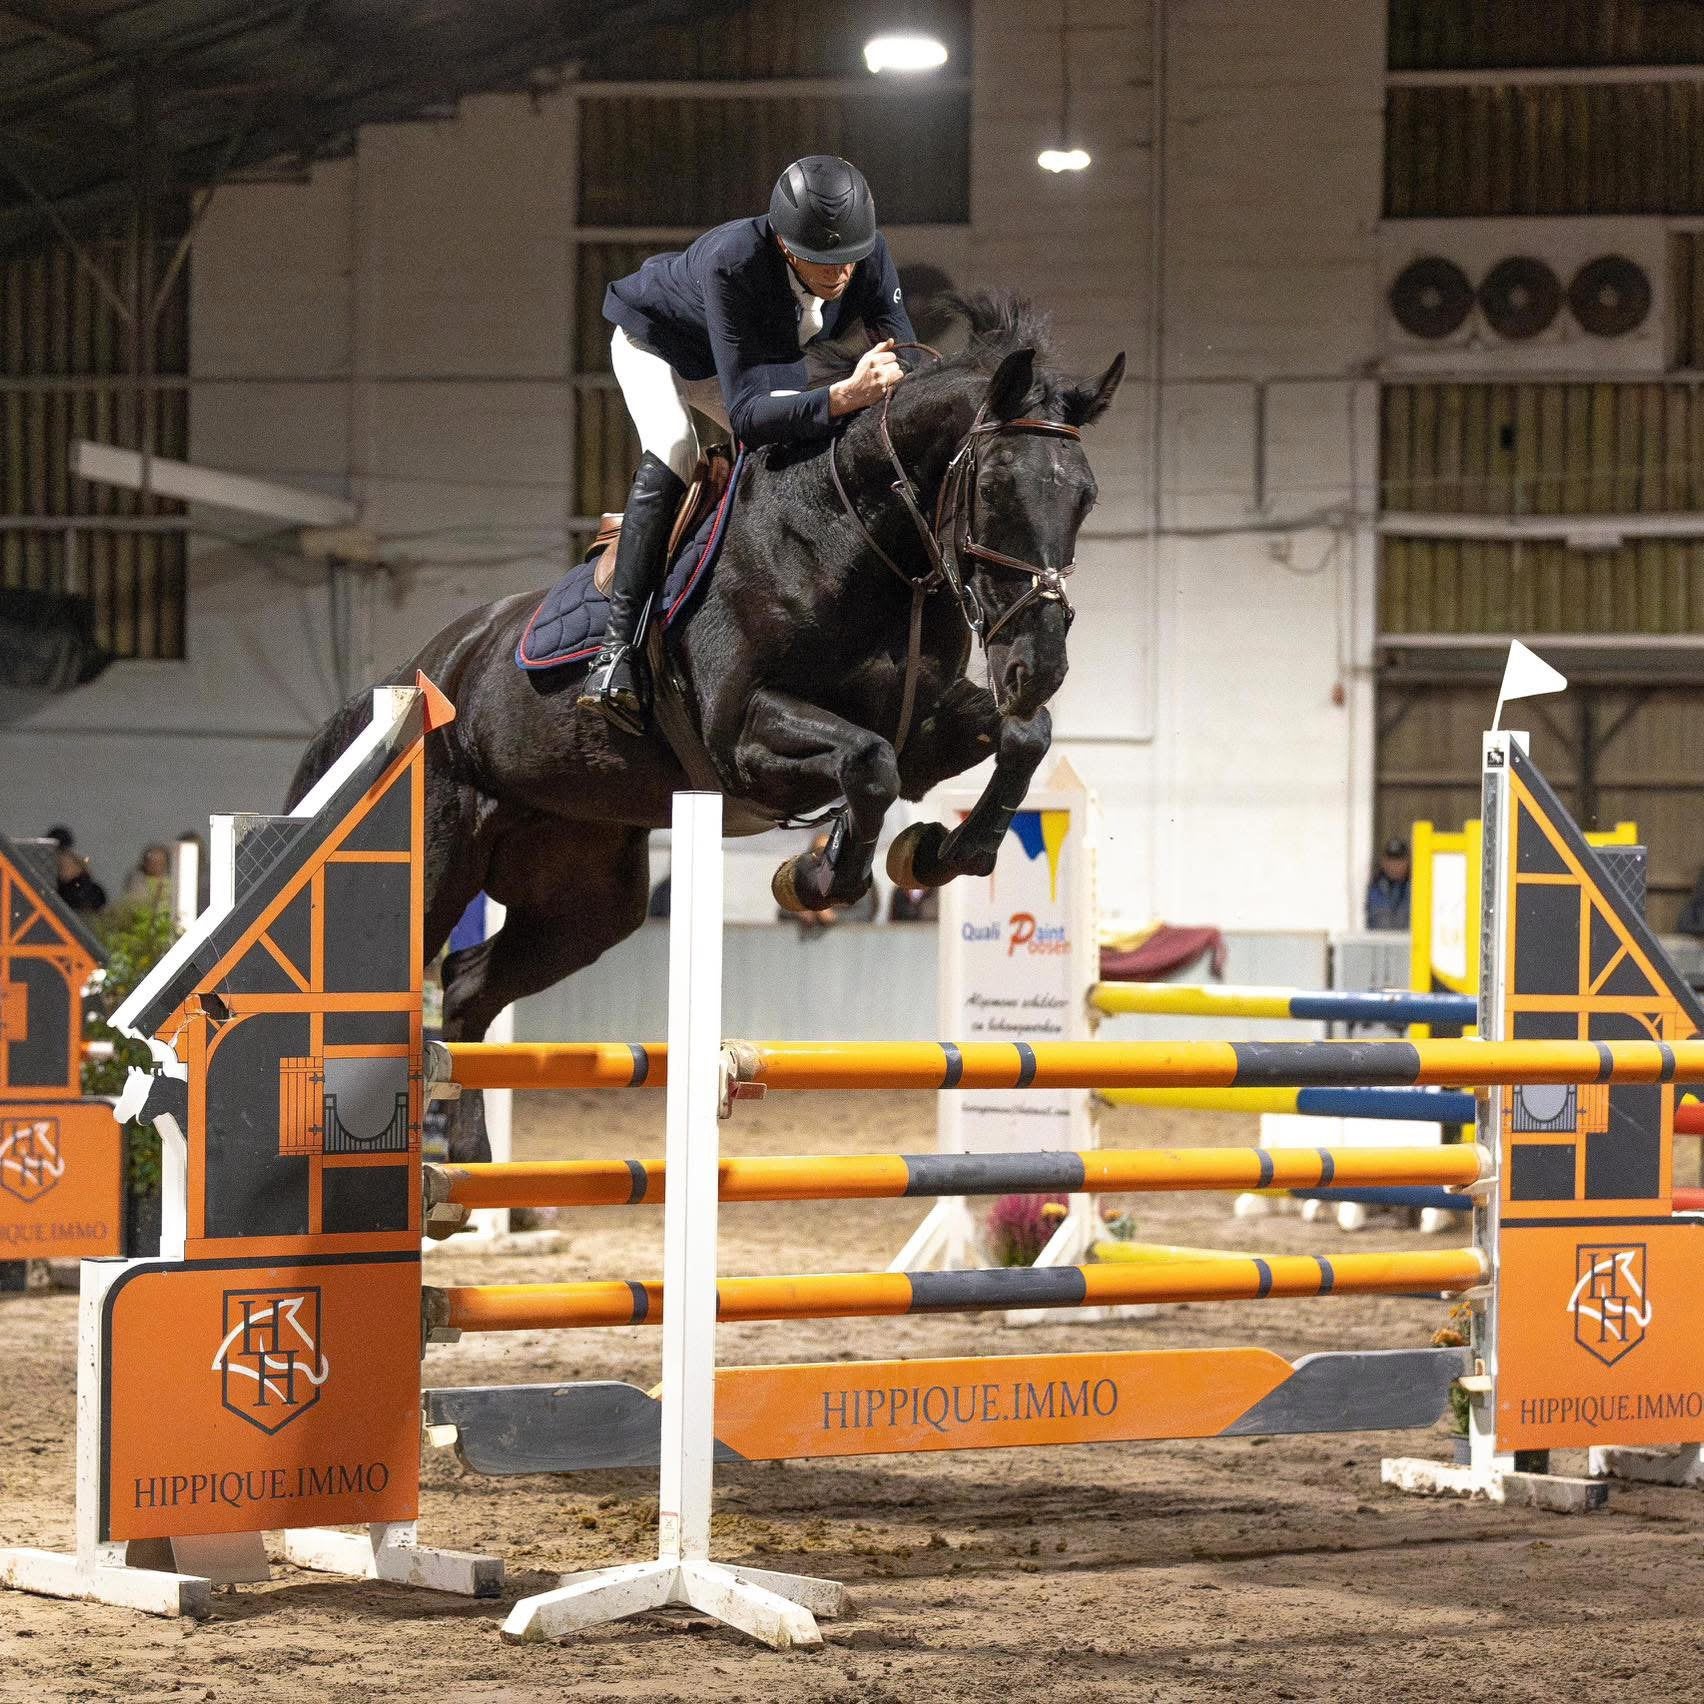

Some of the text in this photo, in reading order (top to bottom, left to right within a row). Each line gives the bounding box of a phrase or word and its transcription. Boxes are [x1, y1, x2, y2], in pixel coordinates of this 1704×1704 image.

[822, 1378, 1119, 1432] HIPPIQUE.IMMO
[1520, 1391, 1703, 1428] HIPPIQUE.IMMO
[134, 1462, 389, 1508] HIPPIQUE.IMMO
